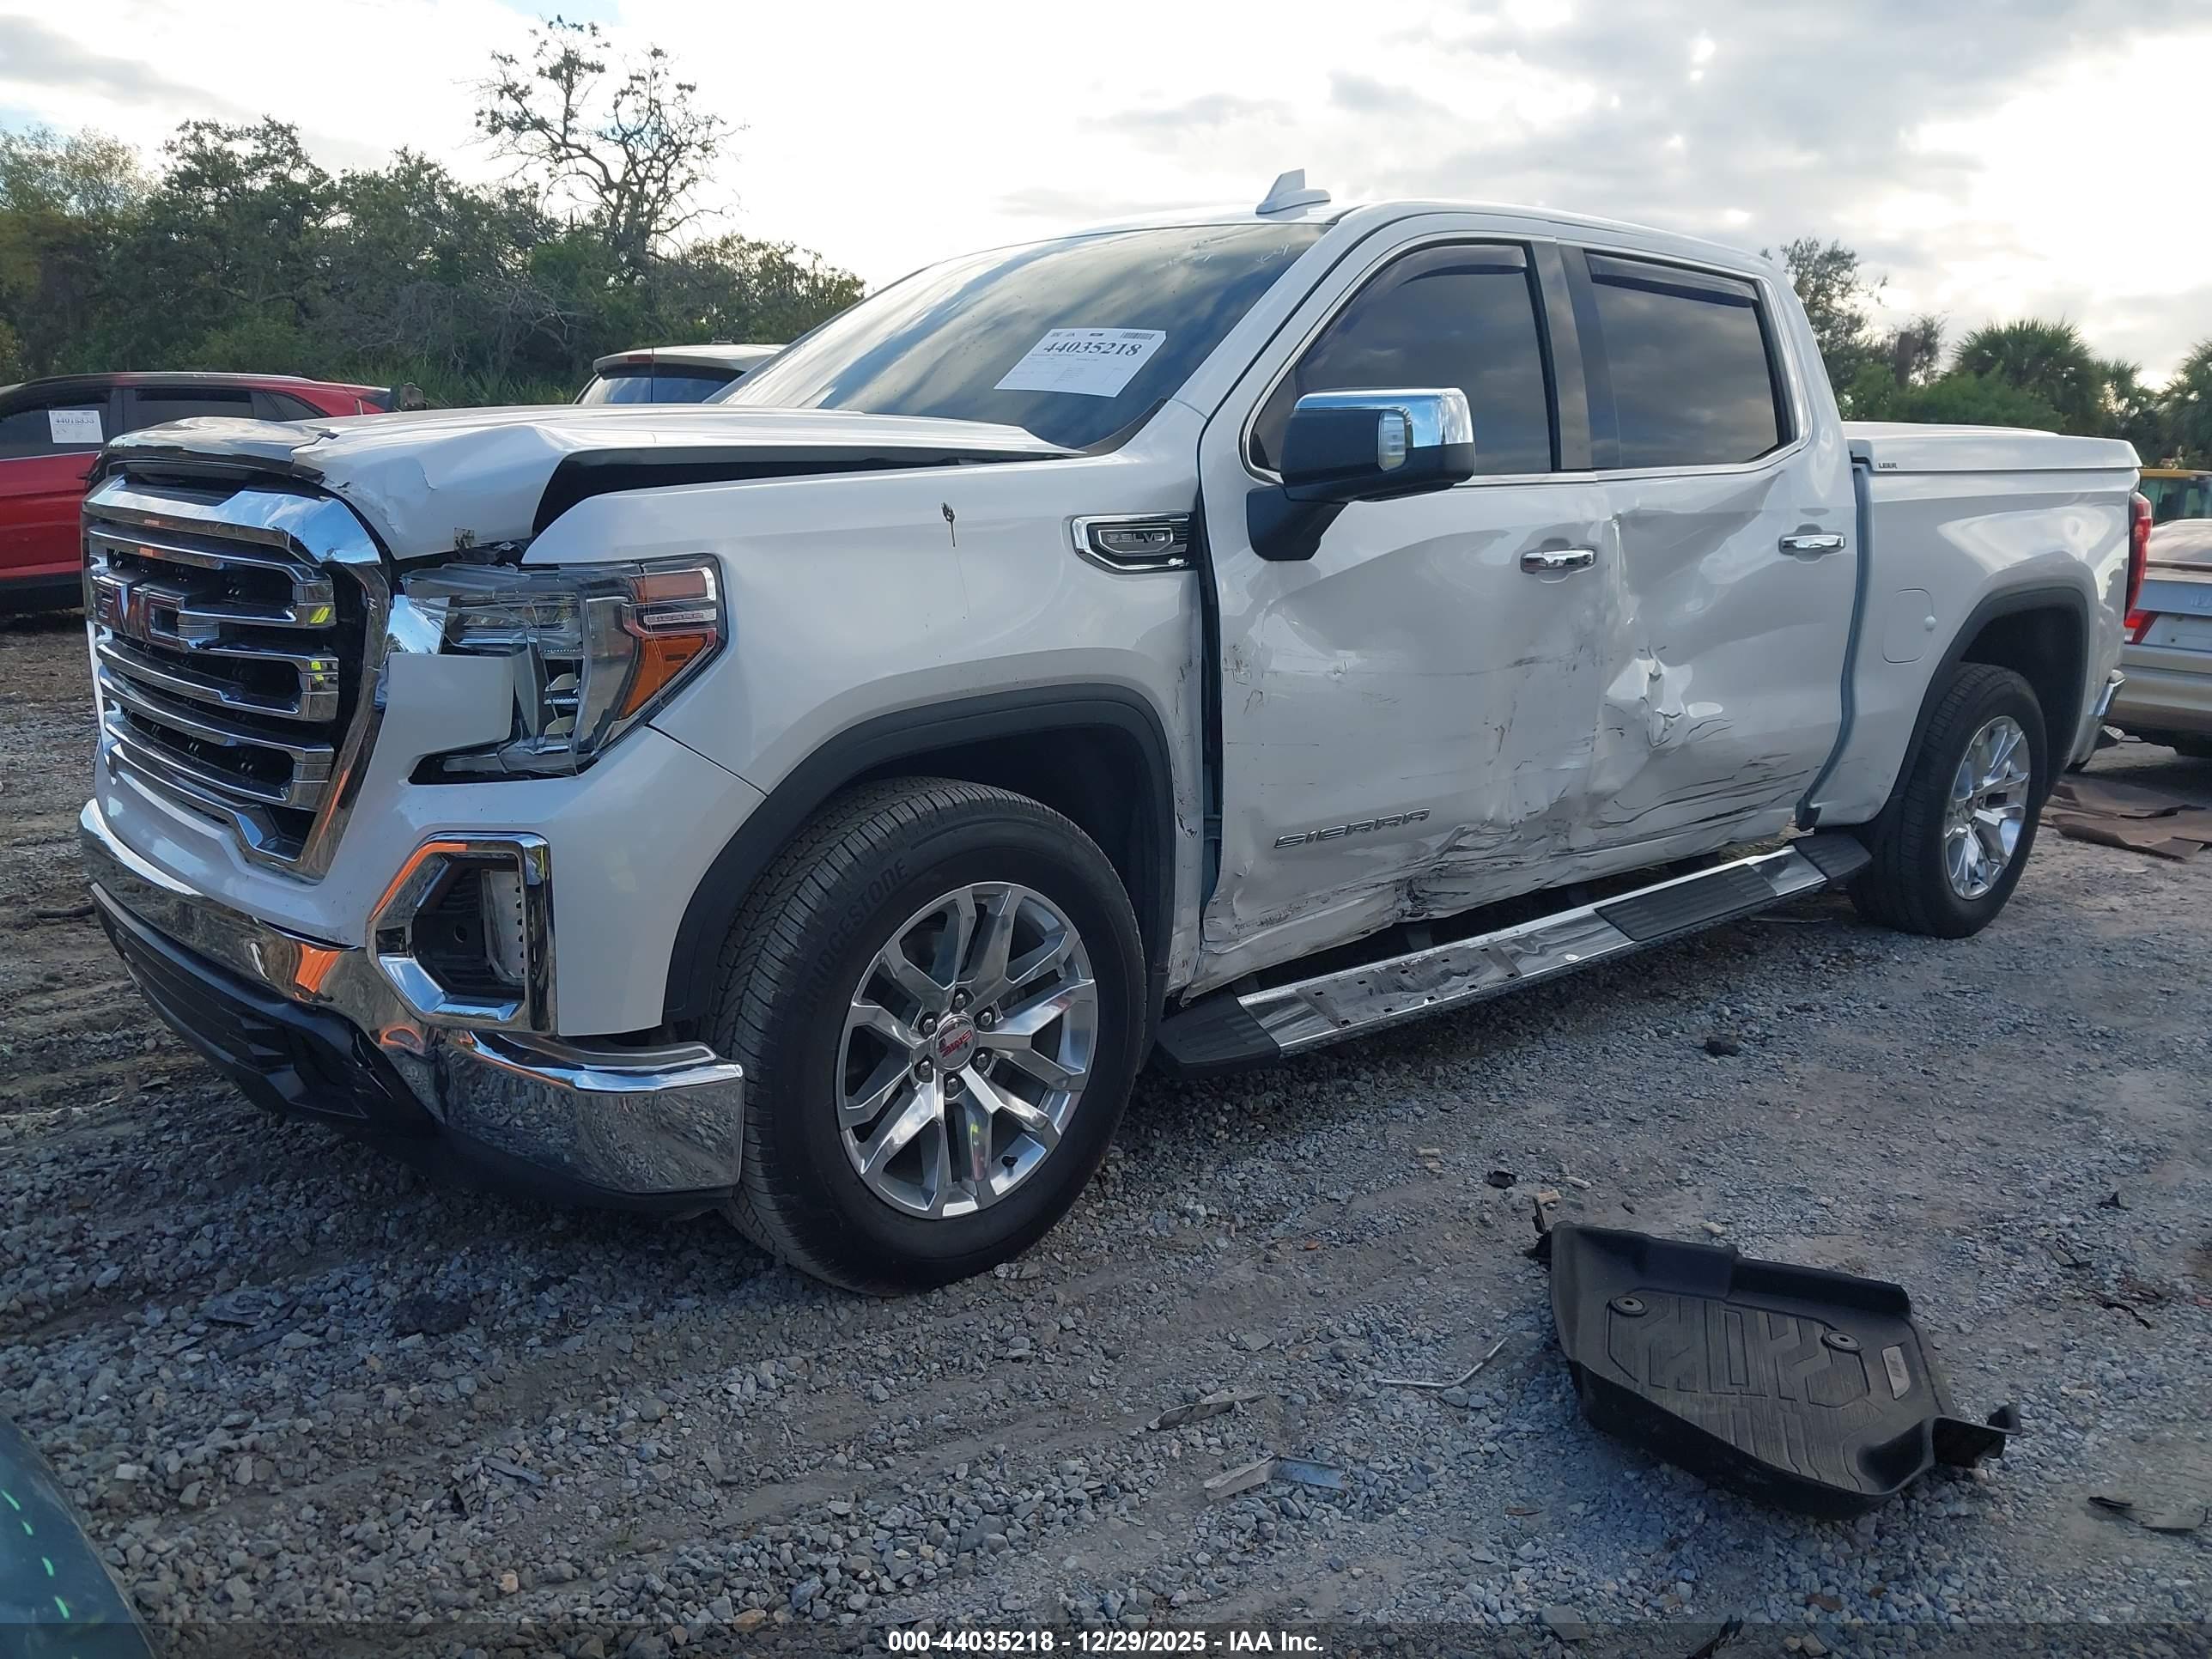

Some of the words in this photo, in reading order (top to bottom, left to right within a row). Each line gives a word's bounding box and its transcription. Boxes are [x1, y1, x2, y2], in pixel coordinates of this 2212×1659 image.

[1043, 341, 1143, 356] 44035218
[91, 576, 185, 652] GMC
[1274, 808, 1431, 848] SIERRA
[939, 1029, 973, 1058] GMC
